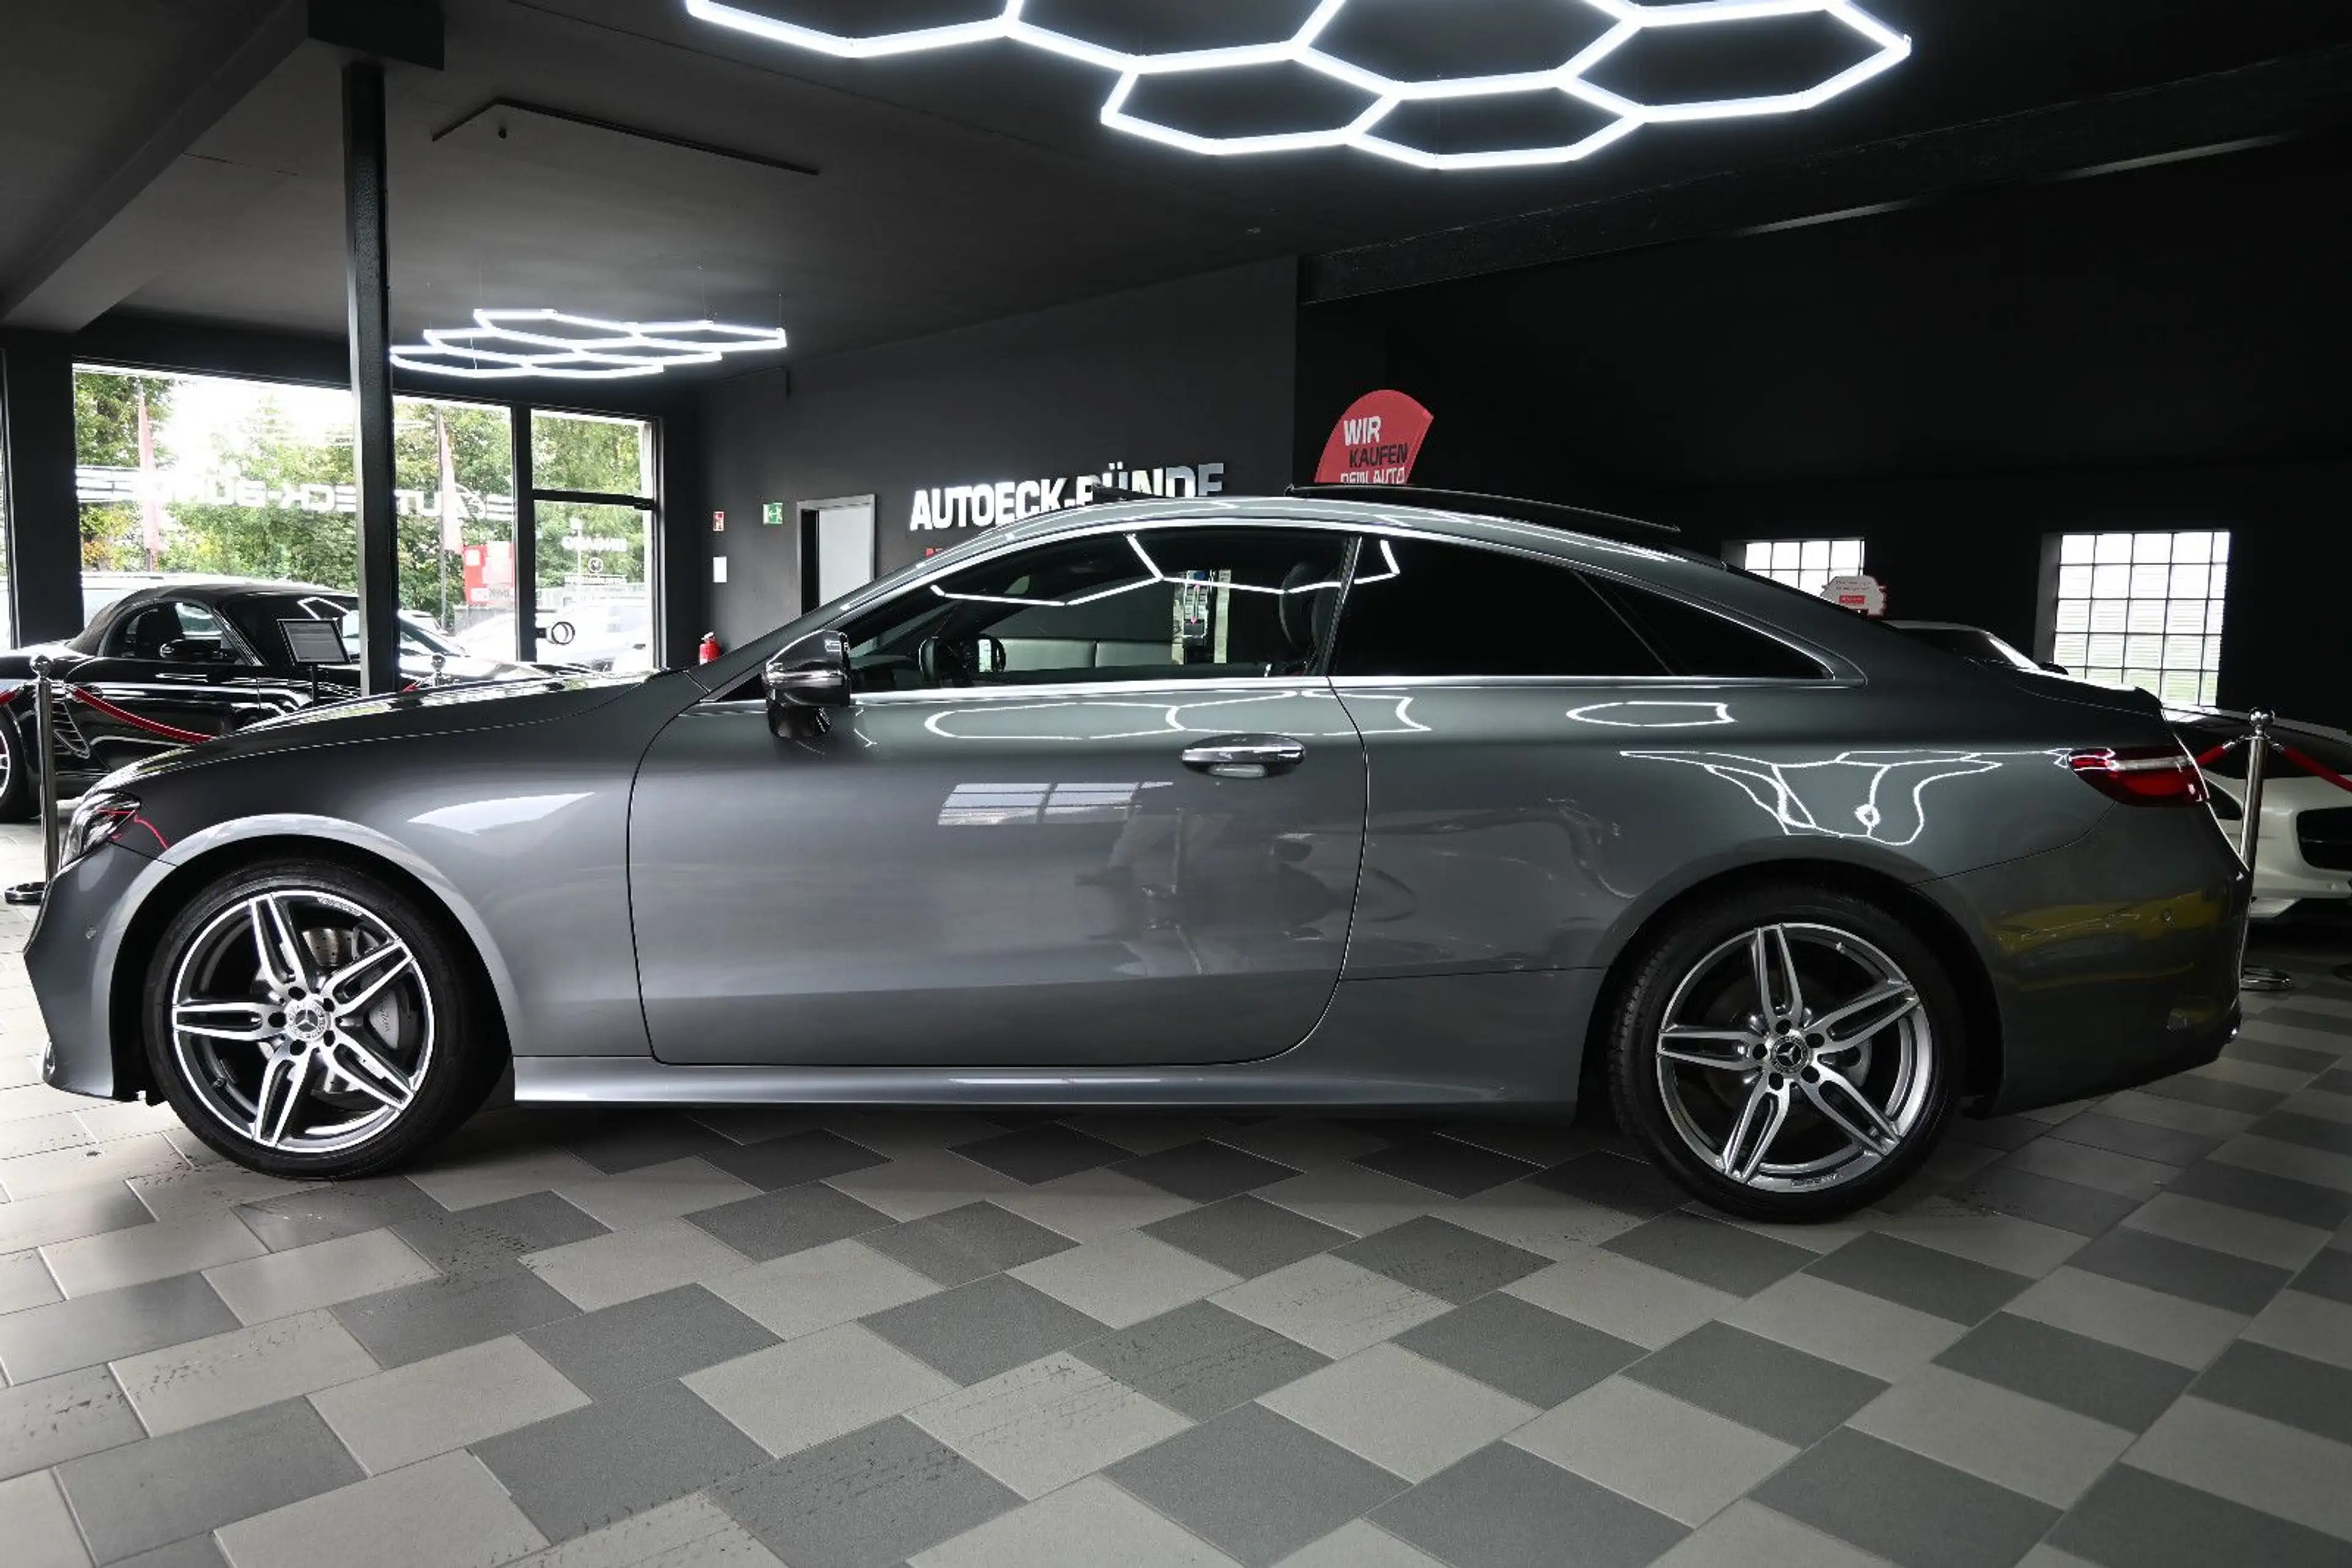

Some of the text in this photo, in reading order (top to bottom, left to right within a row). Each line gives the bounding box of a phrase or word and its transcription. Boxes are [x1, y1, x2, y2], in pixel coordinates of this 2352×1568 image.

[1343, 416, 1381, 446] WIR
[1349, 442, 1408, 468] KAUFEN
[1340, 466, 1405, 484] DEIN AUTO
